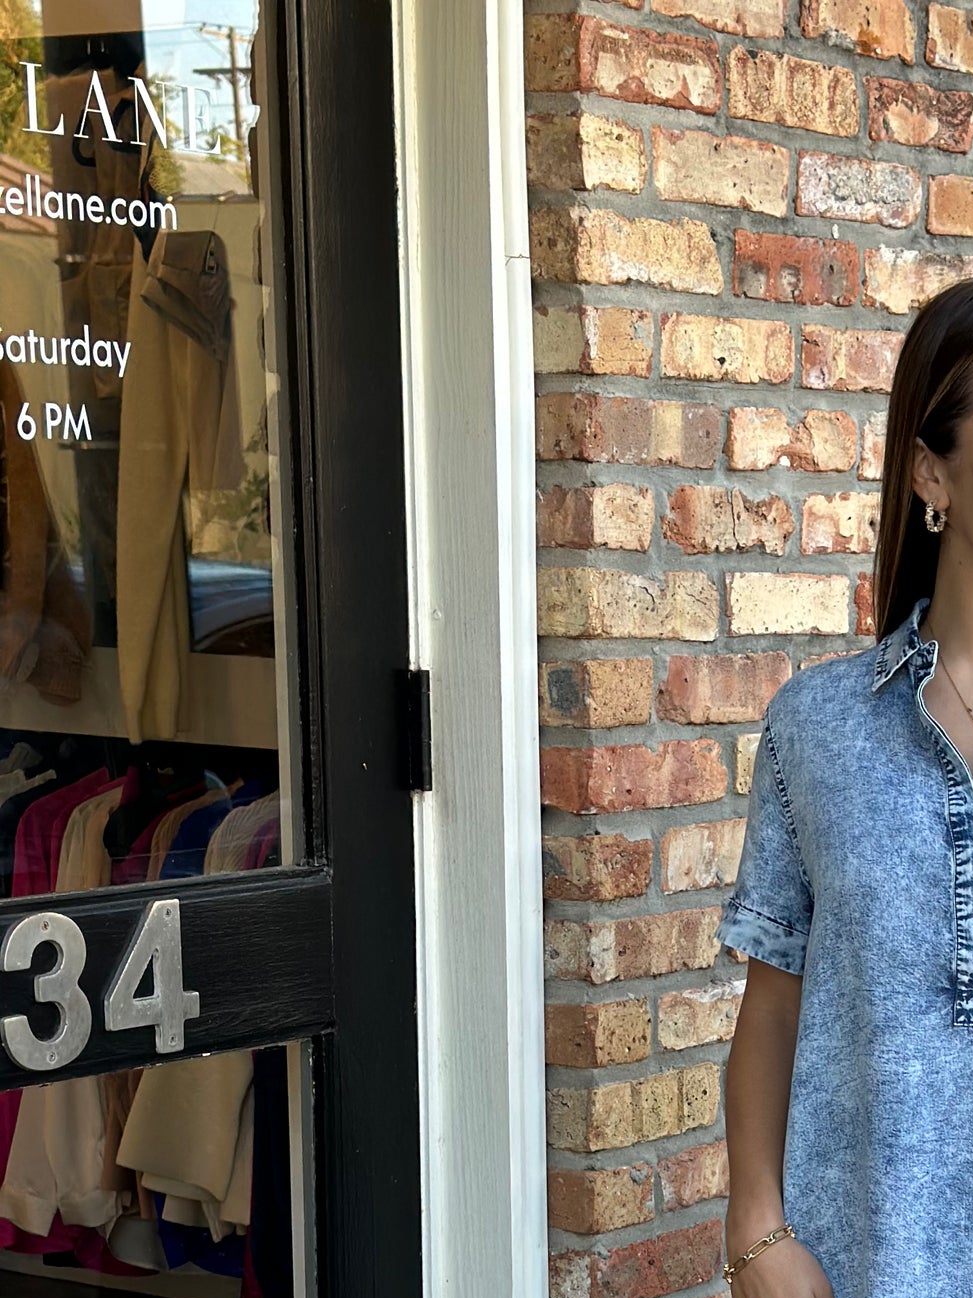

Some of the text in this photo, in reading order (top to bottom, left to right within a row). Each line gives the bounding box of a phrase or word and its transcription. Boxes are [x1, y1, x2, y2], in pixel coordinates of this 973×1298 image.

[19, 61, 222, 156] LANE
[0, 325, 131, 378] aturday
[17, 402, 92, 441] 6 PM
[1, 898, 200, 1071] 34
